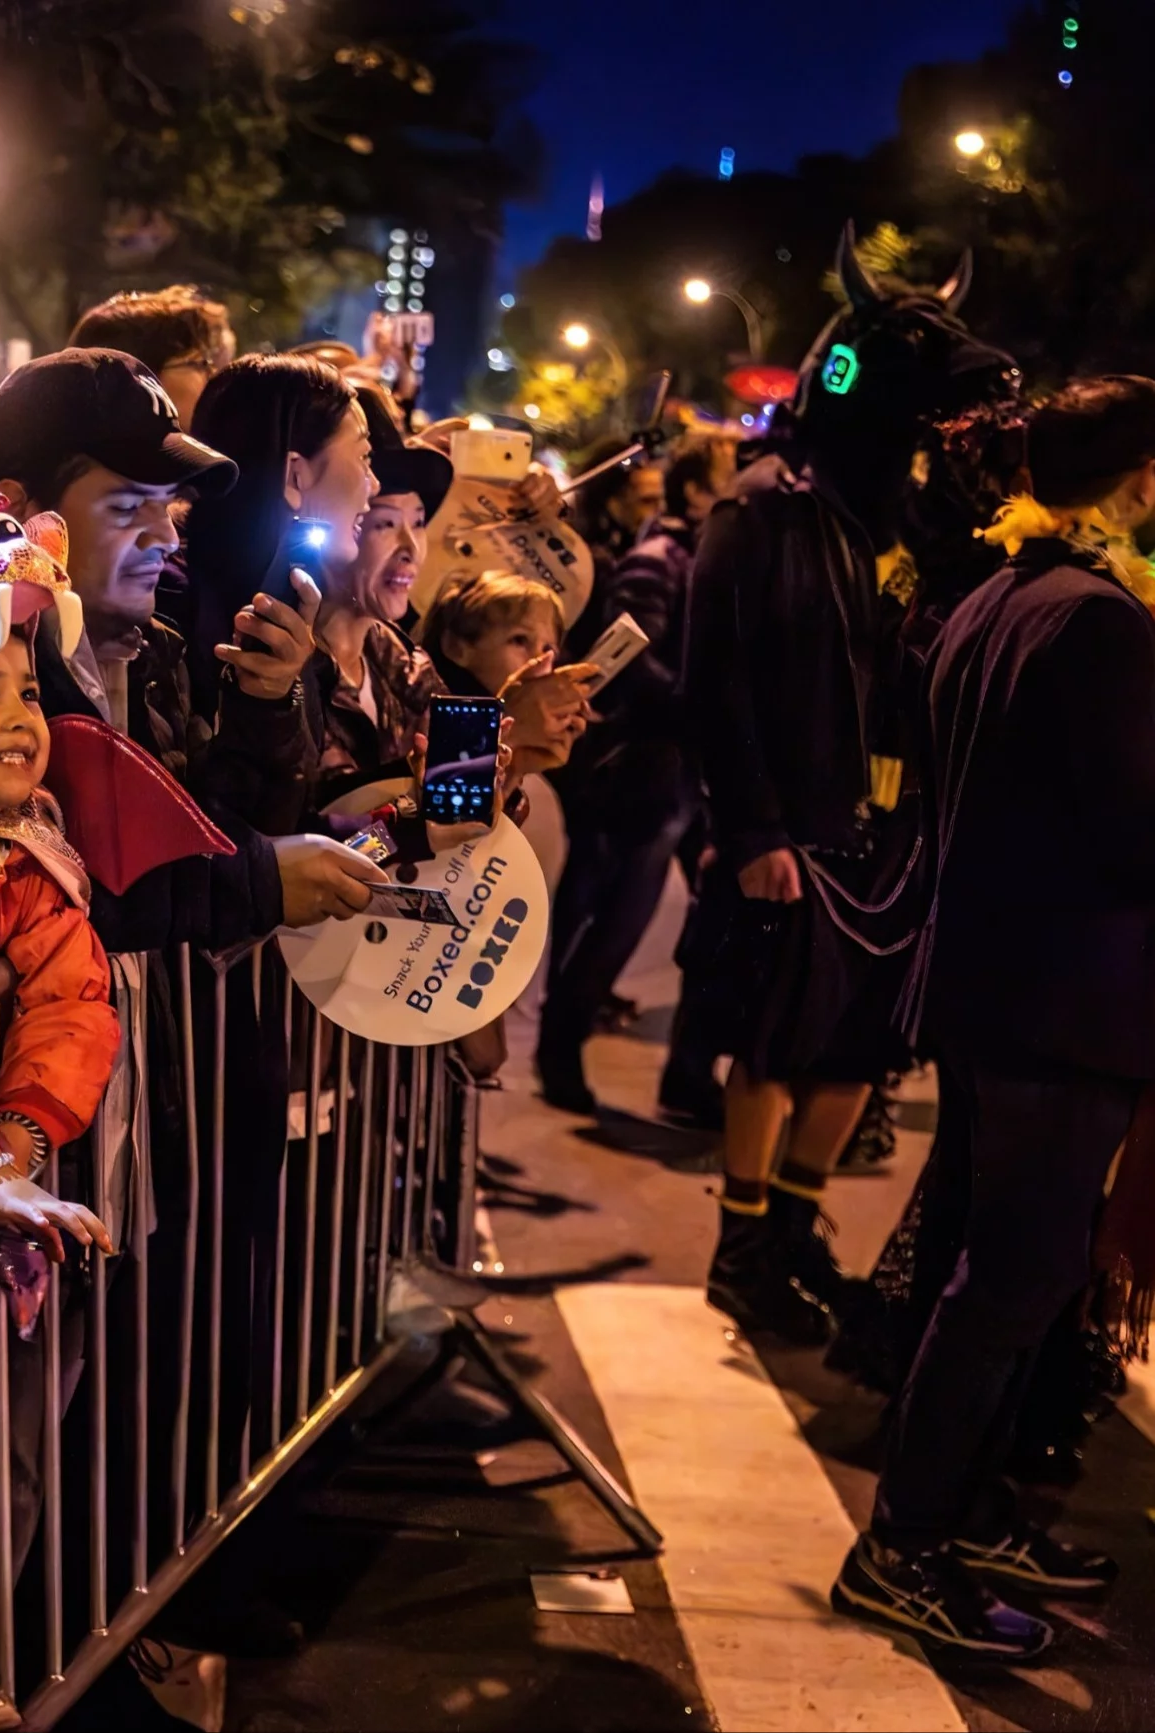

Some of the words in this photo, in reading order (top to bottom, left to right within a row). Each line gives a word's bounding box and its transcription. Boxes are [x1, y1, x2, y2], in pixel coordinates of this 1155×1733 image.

[383, 957, 415, 999] Snack
[406, 923, 432, 953] Your
[445, 856, 465, 884] Off
[405, 856, 508, 1014] Boxed.com
[455, 897, 529, 1010] BOXED
